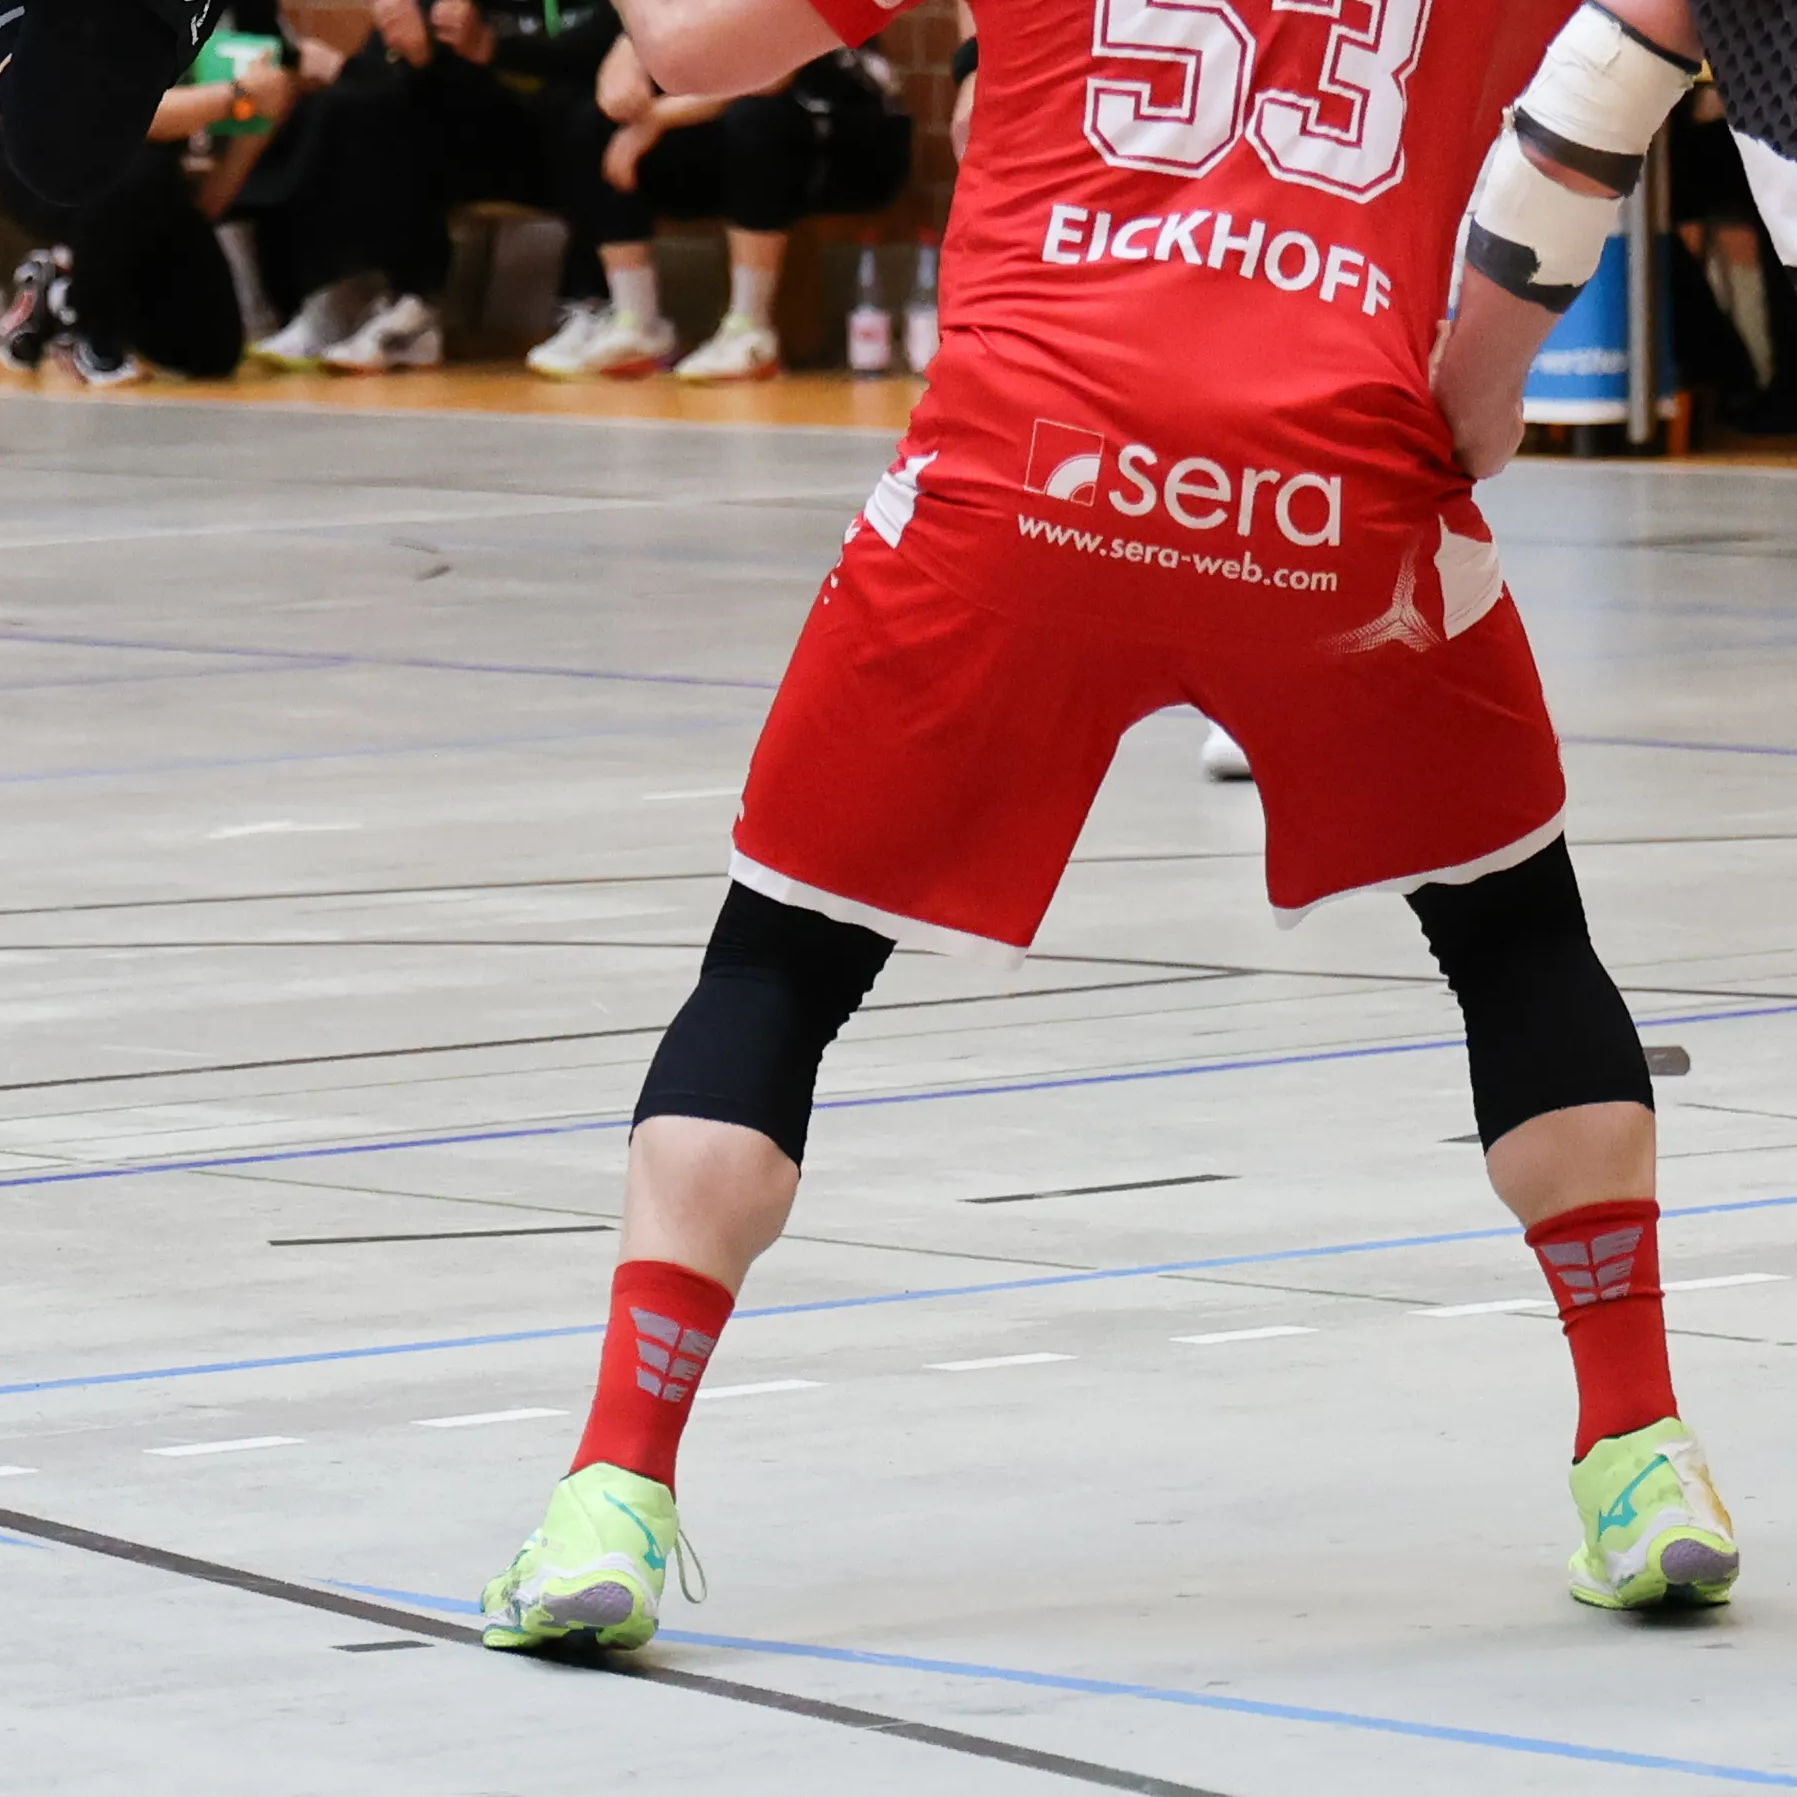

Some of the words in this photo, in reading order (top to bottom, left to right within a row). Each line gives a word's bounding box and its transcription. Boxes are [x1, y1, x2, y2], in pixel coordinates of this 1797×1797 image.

[1041, 203, 1392, 318] EICKHOFF
[1109, 443, 1342, 548] sera
[1017, 513, 1339, 593] www.sera-web.com
